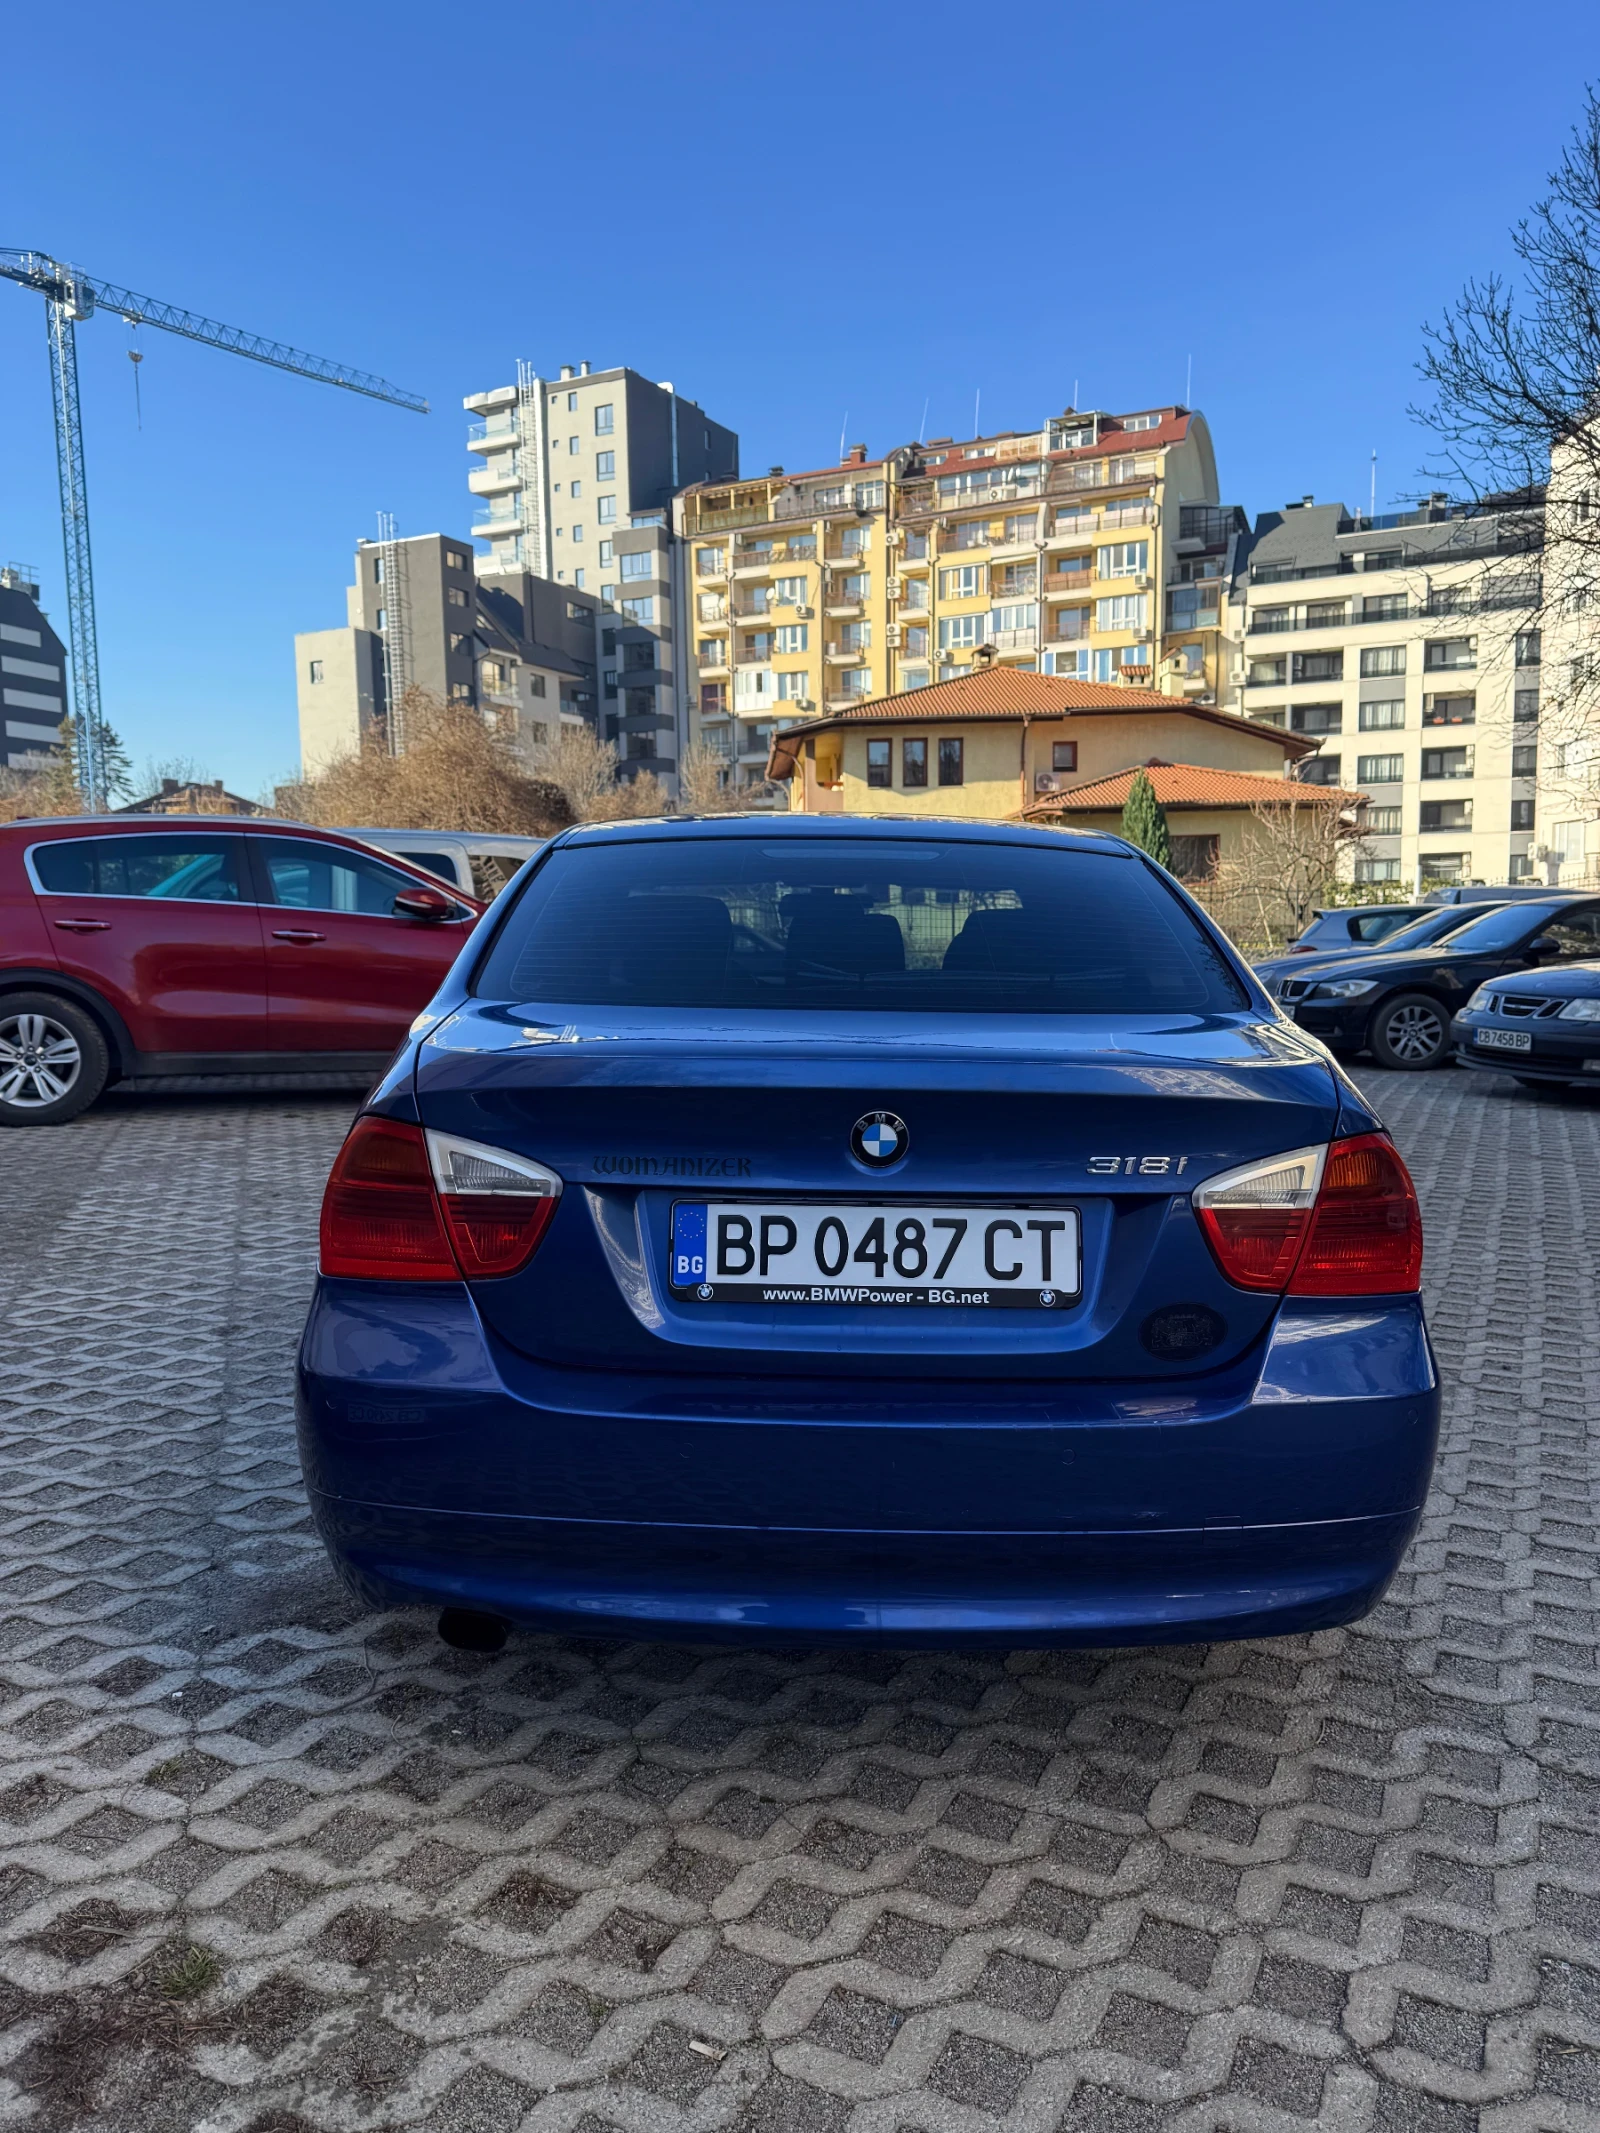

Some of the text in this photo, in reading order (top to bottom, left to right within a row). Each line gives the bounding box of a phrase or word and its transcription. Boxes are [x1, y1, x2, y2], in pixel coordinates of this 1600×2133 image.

[1479, 1030, 1530, 1048] CB 7458 BP
[856, 1113, 905, 1132] BMW
[593, 1156, 752, 1178] WOMANIZER
[1086, 1156, 1189, 1175] 318i
[716, 1214, 1066, 1282] BP 0487 CT
[677, 1255, 704, 1275] BG
[763, 1288, 914, 1303] www.BMWPower
